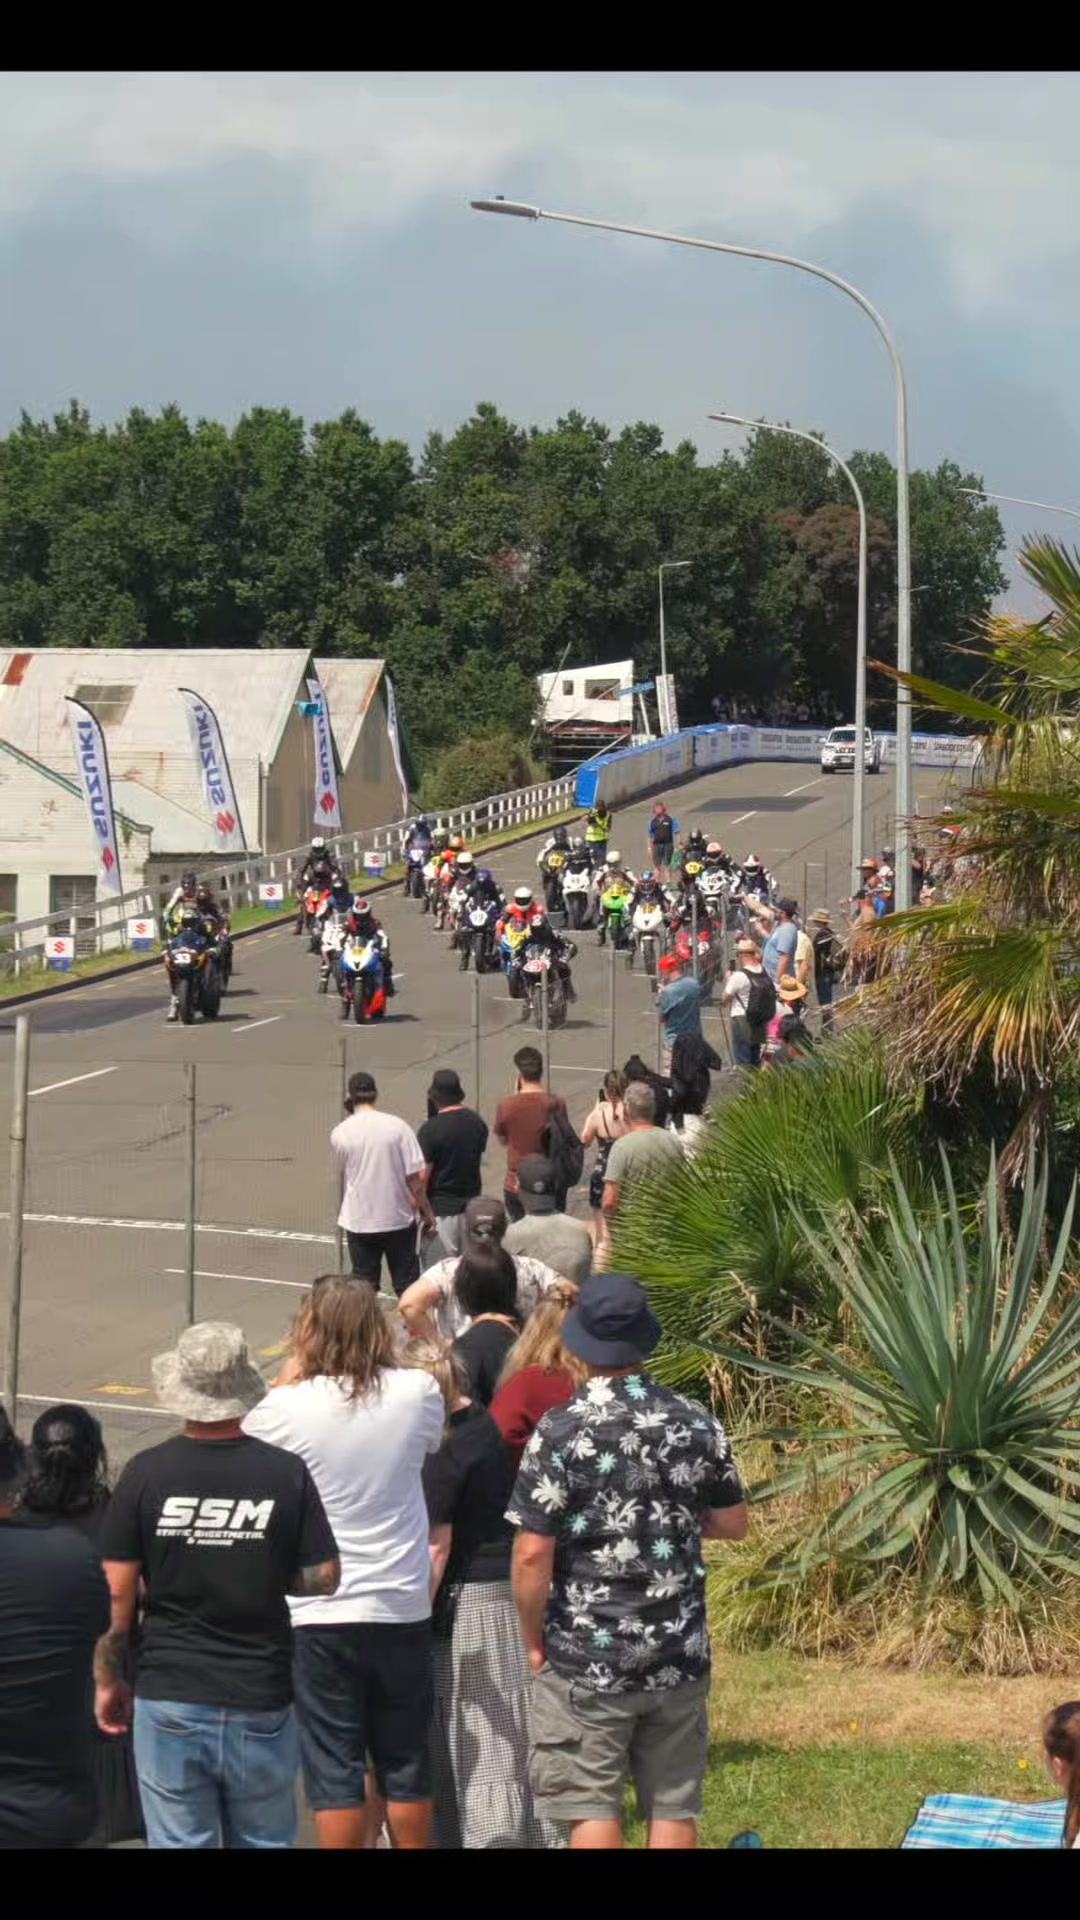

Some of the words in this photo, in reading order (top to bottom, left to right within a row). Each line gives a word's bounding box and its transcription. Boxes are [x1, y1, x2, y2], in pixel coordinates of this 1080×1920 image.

[157, 1497, 275, 1530] SSM
[156, 1529, 193, 1537] STATIC
[194, 1530, 265, 1540] SHEETMETAL
